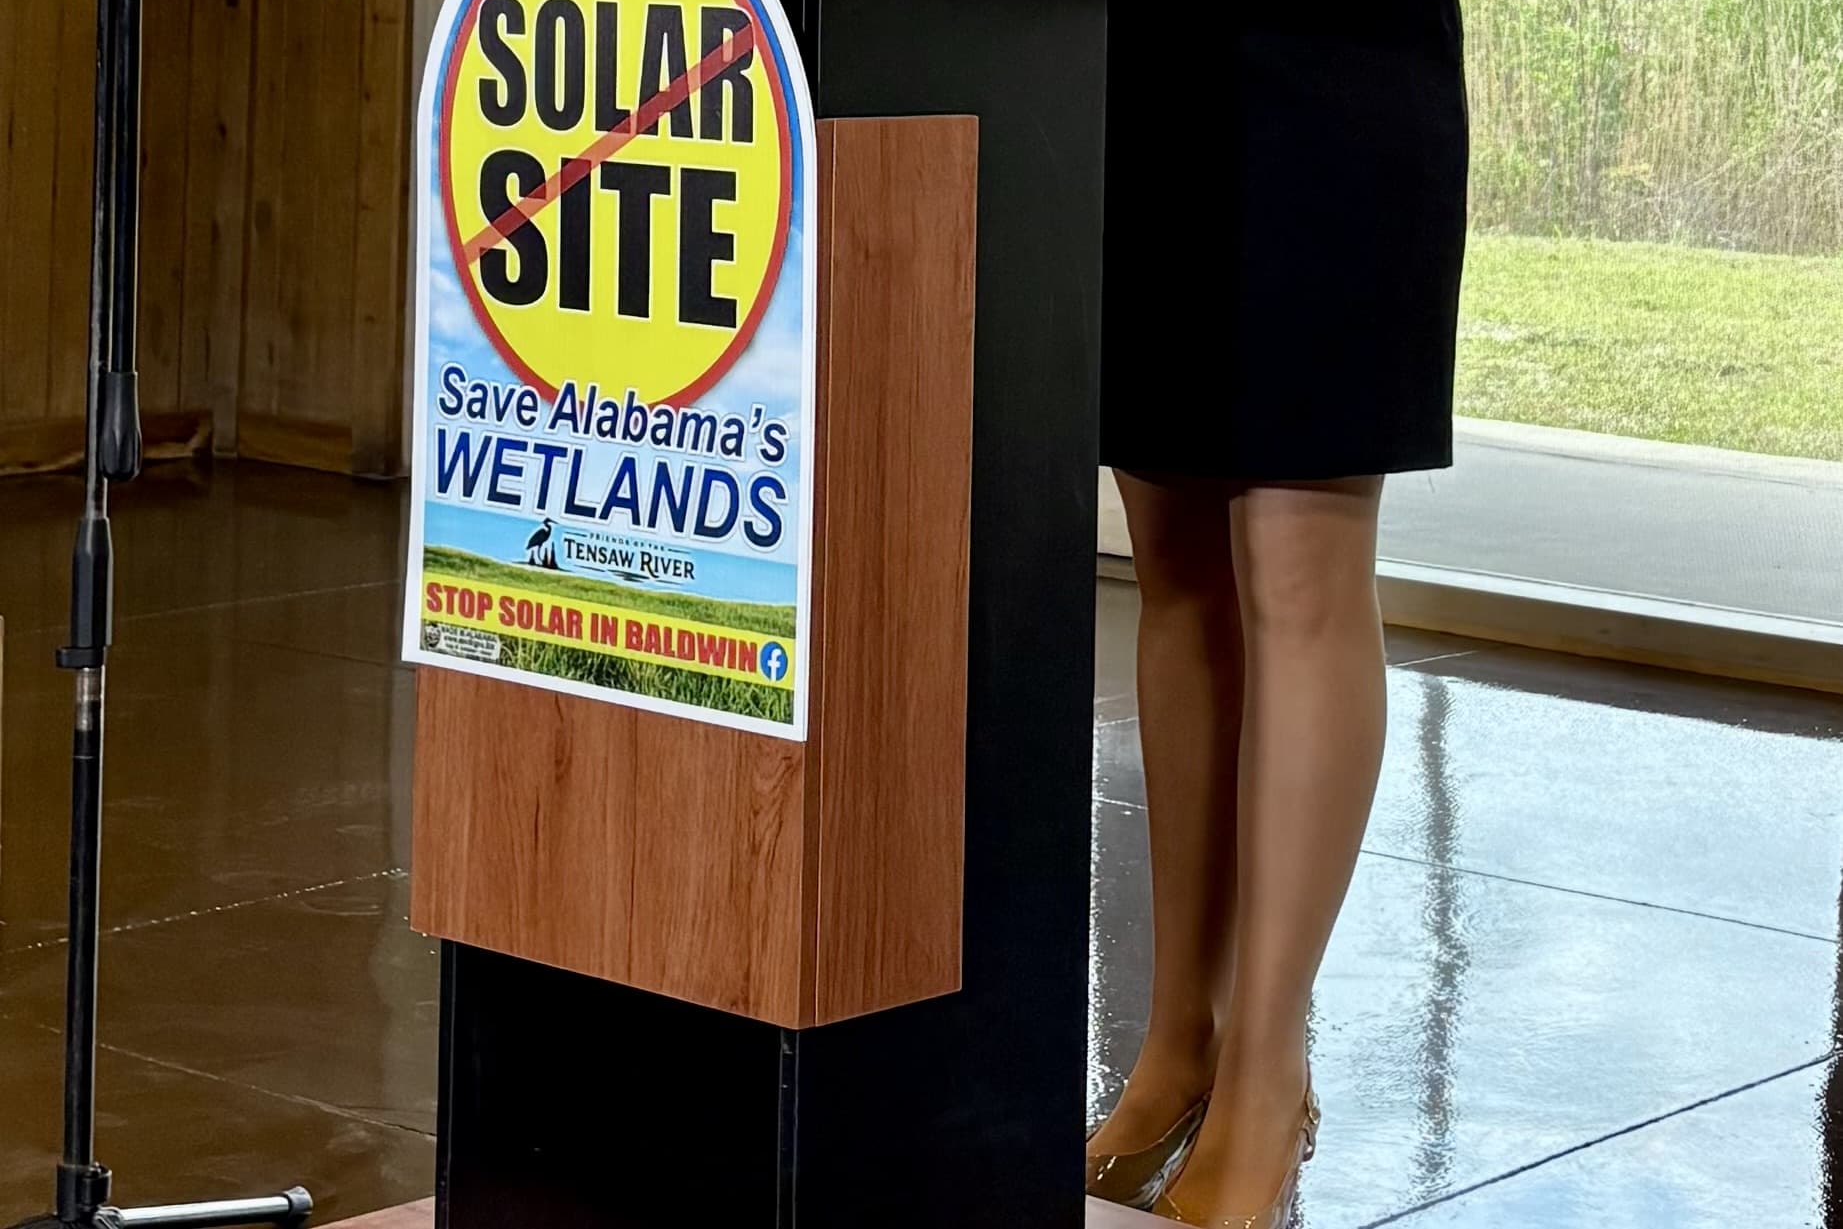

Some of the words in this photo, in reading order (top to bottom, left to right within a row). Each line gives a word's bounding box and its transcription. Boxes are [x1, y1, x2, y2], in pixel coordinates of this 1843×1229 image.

[479, 150, 738, 329] SITE
[439, 366, 538, 426] Save
[438, 428, 786, 548] WETLANDS
[564, 538, 635, 569] TENSAW
[640, 551, 695, 580] RIVER
[426, 581, 493, 621] STOP
[499, 596, 583, 641] SOLAR
[590, 612, 618, 647] IN
[625, 619, 757, 674] BALDWIN
